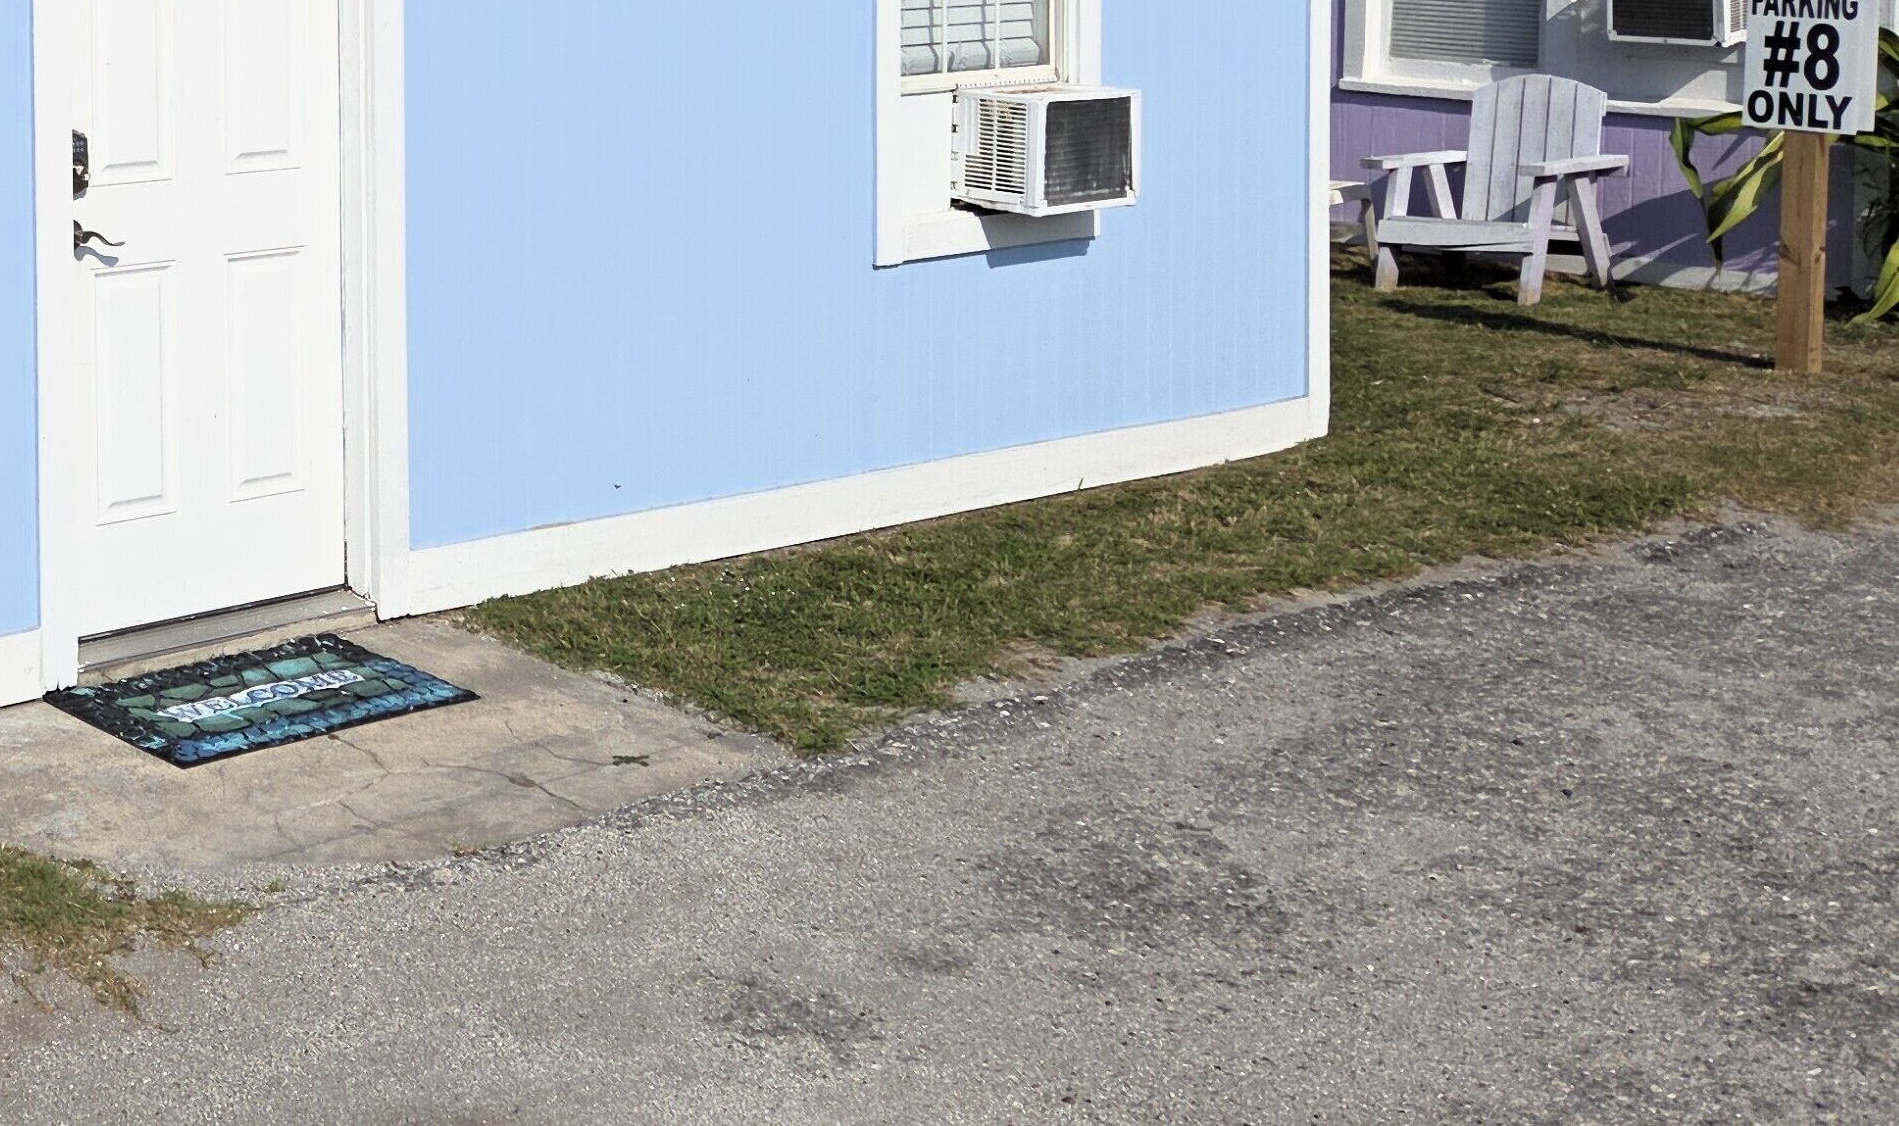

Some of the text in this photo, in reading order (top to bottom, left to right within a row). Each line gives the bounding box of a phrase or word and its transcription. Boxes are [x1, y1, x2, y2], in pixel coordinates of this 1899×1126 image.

[1763, 21, 1840, 90] #8
[1748, 90, 1852, 129] ONLY
[164, 671, 359, 720] WELCOME
